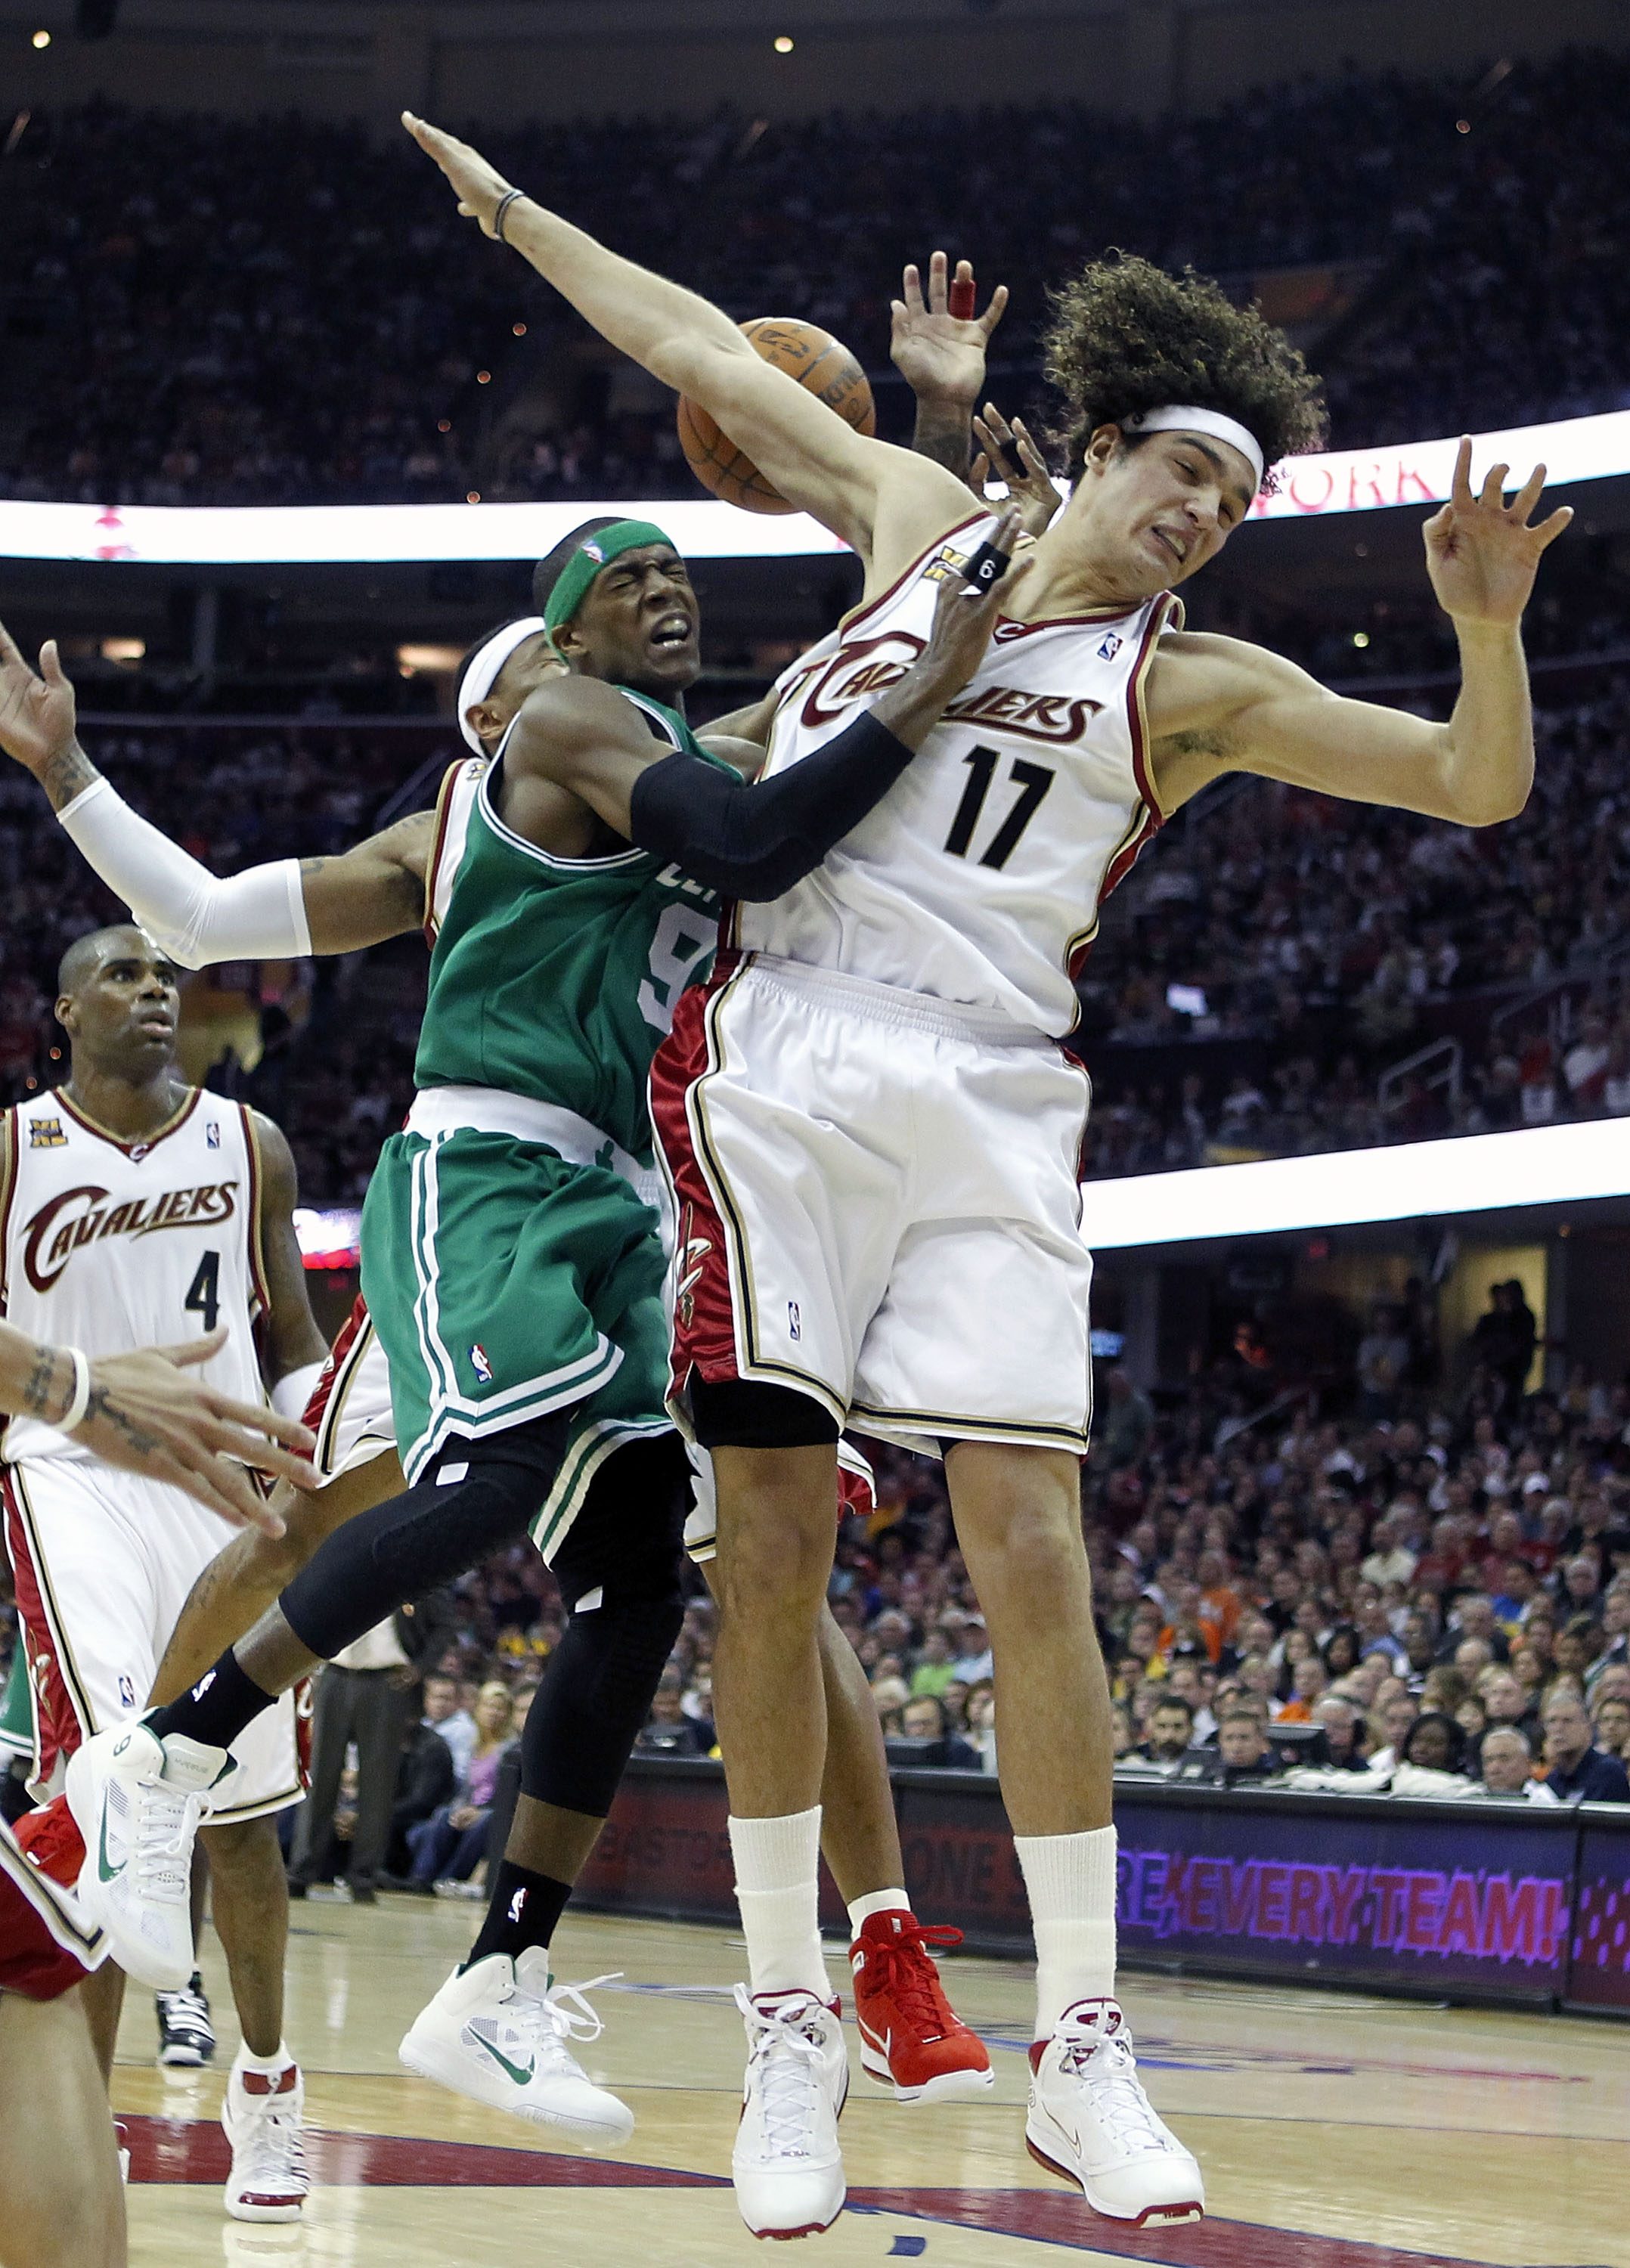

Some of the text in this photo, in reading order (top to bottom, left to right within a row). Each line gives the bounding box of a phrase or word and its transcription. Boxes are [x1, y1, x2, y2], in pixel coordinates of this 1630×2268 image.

[1255, 462, 1439, 516] ORK
[943, 744, 1056, 871] 17
[637, 902, 718, 1036] 9
[20, 1182, 239, 1294] CAVALIERS
[185, 1250, 221, 1332] 4
[1188, 1861, 1364, 1938] EVERY
[1371, 1874, 1560, 1957] TEAM!
